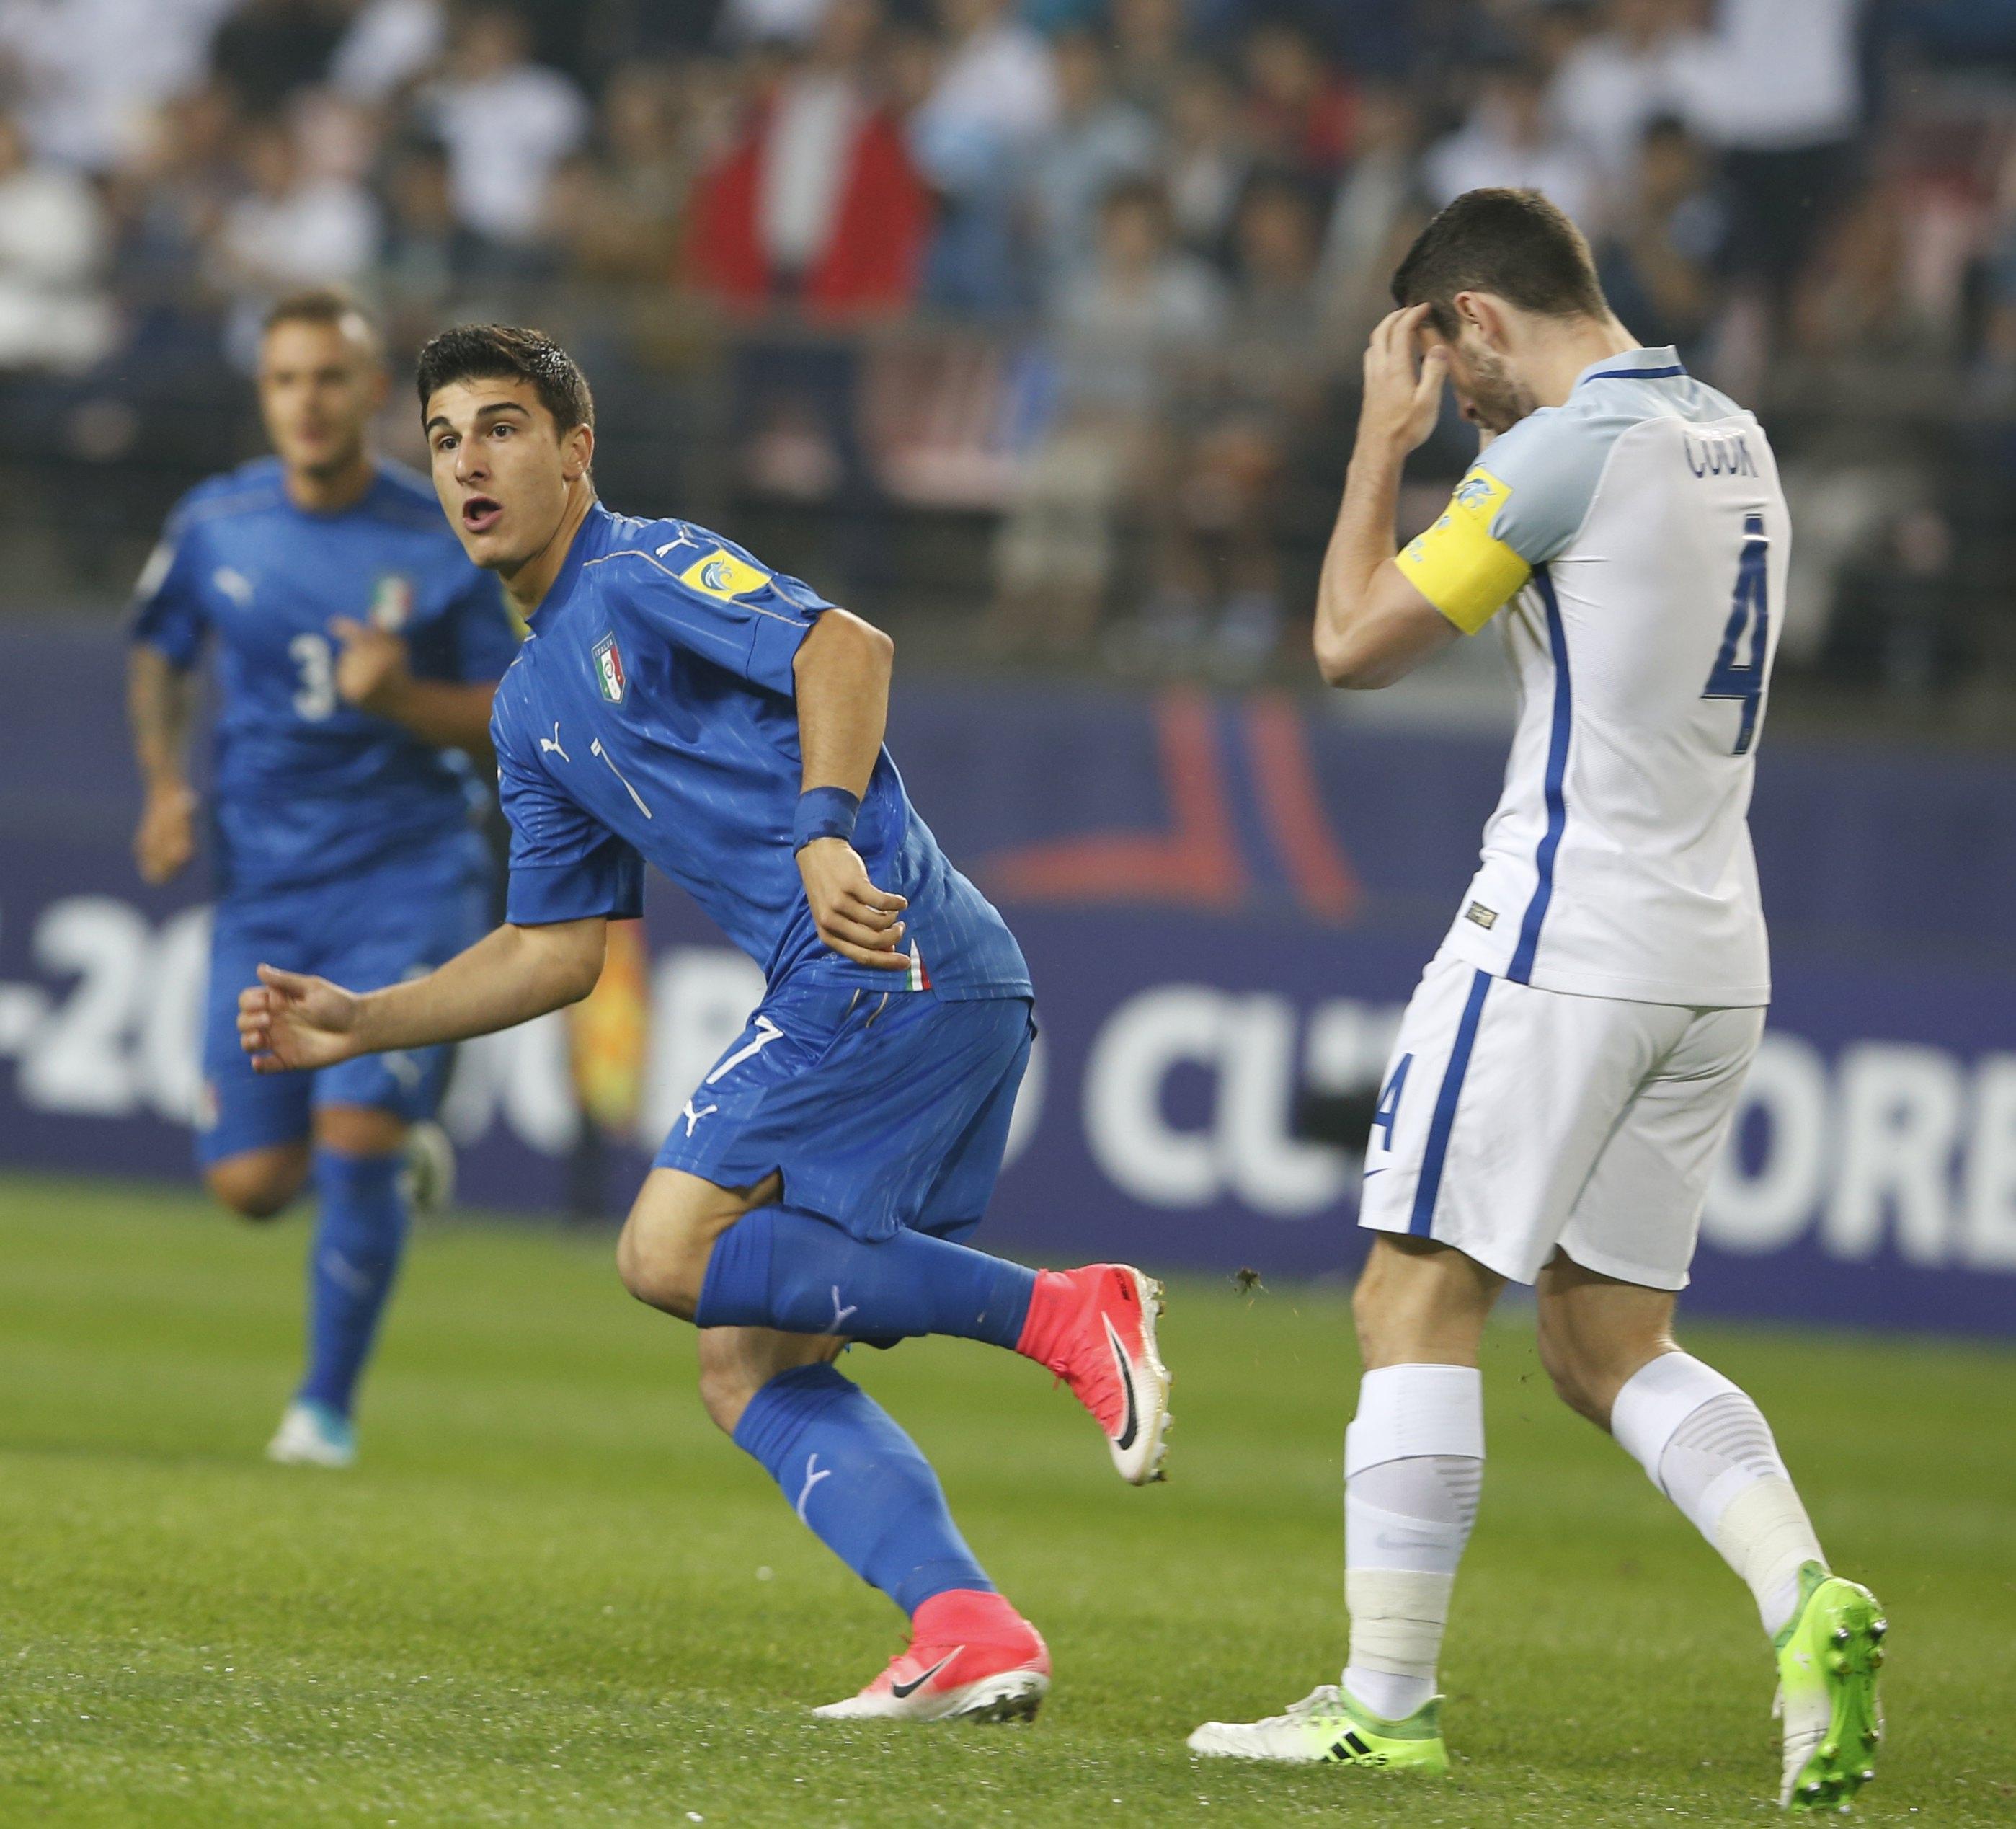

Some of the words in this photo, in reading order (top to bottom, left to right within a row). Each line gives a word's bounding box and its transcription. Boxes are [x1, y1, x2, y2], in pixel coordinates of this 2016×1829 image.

[1683, 430, 1759, 479] COOK
[594, 639, 613, 658] ITALIA
[1700, 513, 1769, 755] 4
[290, 632, 336, 722] 3
[706, 1014, 784, 1084] 7
[1372, 1053, 1414, 1152] 4
